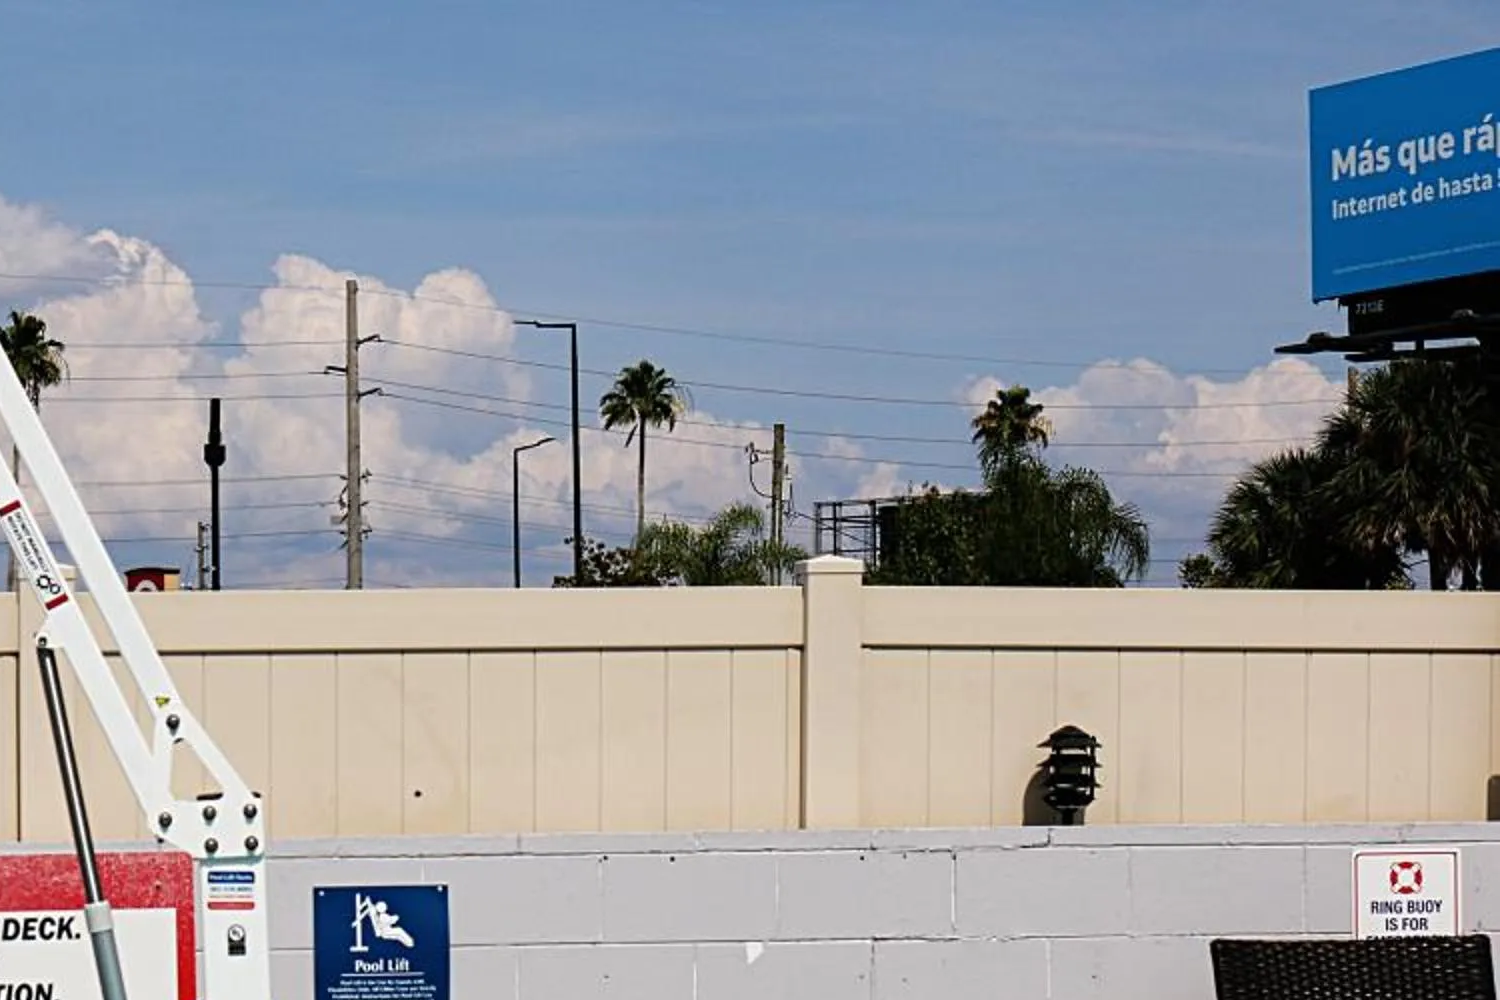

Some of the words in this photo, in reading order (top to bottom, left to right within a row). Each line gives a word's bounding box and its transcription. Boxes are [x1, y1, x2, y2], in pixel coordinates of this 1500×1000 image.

[1331, 138, 1391, 182] Más
[1398, 130, 1455, 175] que
[1462, 113, 1500, 158] rá
[1332, 187, 1407, 221] Internet
[1411, 181, 1434, 204] de
[1439, 171, 1493, 199] hasta
[1371, 901, 1403, 914] RING
[1407, 900, 1443, 913] BUOY
[1, 916, 81, 941] DECK.
[1385, 918, 1399, 931] IS
[1401, 917, 1429, 931] FOR
[355, 958, 384, 972] Pool
[388, 957, 410, 971] Lift
